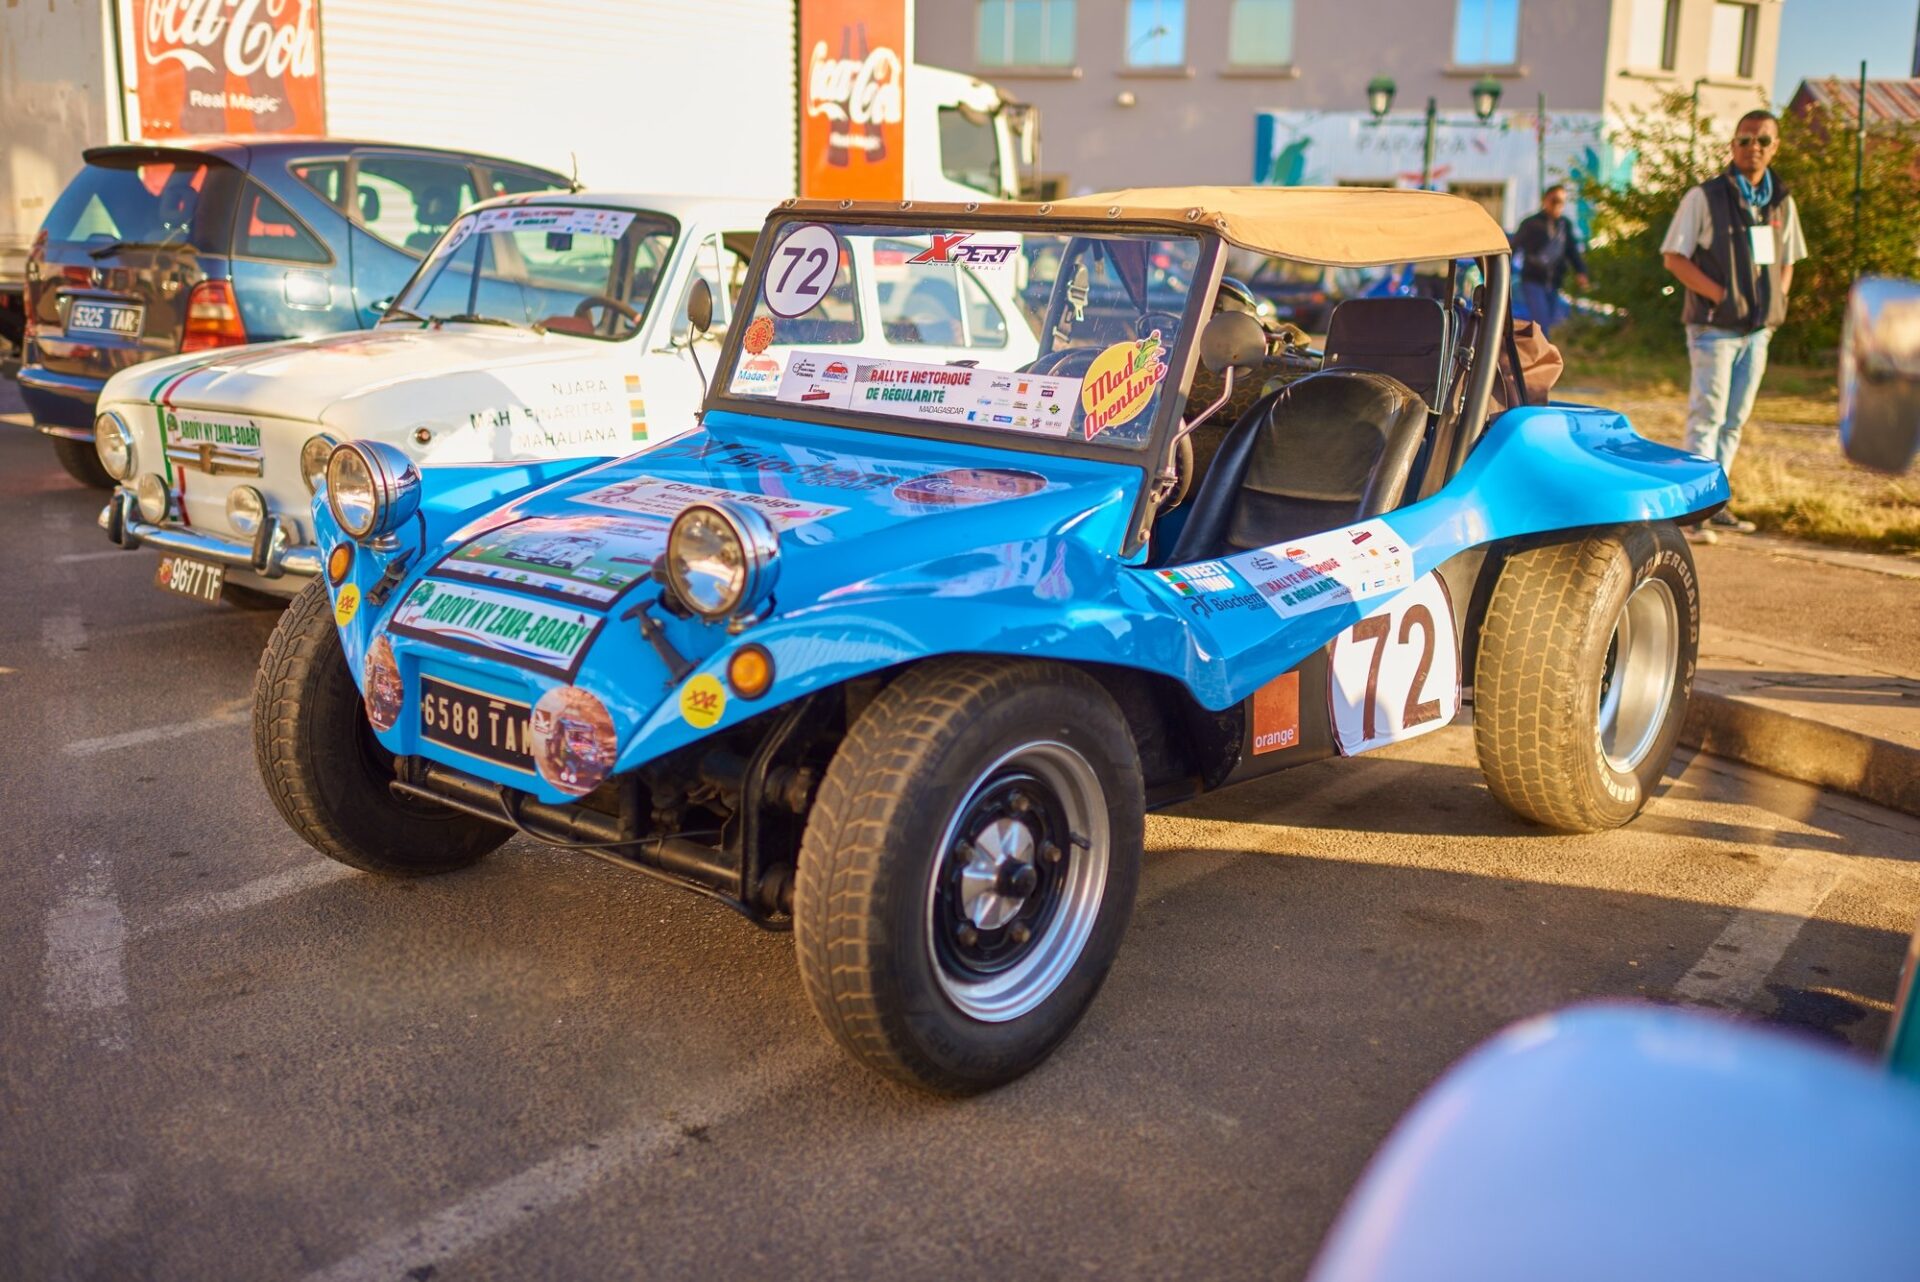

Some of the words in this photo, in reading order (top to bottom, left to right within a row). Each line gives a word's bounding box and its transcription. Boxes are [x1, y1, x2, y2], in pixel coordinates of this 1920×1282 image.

[189, 89, 226, 108] Real
[229, 92, 279, 114] Magic
[905, 233, 1021, 264] XPERT
[775, 247, 829, 296] 72
[74, 306, 105, 328] 5325
[109, 308, 136, 332] TAR
[552, 380, 608, 396] NJARA
[870, 368, 909, 383] RALLYE
[911, 370, 973, 386] HISTORIQUE
[1085, 350, 1134, 407] Mad
[866, 387, 880, 400] DE
[881, 384, 945, 404] RÉGULARITÉ
[1086, 363, 1165, 439] Aventure
[919, 405, 965, 415] MADAGASCAR
[181, 420, 202, 440] AROVY
[203, 422, 214, 441] NY
[214, 423, 261, 447] ZAVA-BOARY
[519, 427, 617, 448] MAHALIANA
[663, 483, 709, 494] Chez
[718, 490, 737, 499] le
[740, 494, 801, 509] Belge
[170, 557, 205, 595] 9677
[205, 566, 221, 600] TF
[1173, 560, 1230, 580] TWEETY
[1267, 573, 1299, 592] RALLYE
[1296, 558, 1341, 581] HISTORIQUE
[1210, 592, 1265, 612] Biochem
[1280, 593, 1297, 607] DE
[424, 594, 478, 626] AROVY
[466, 601, 500, 630] NY
[484, 606, 591, 656] ZAVA-BOARY
[1352, 603, 1442, 742] 72
[424, 693, 479, 741] 6588
[1255, 727, 1295, 748] orange
